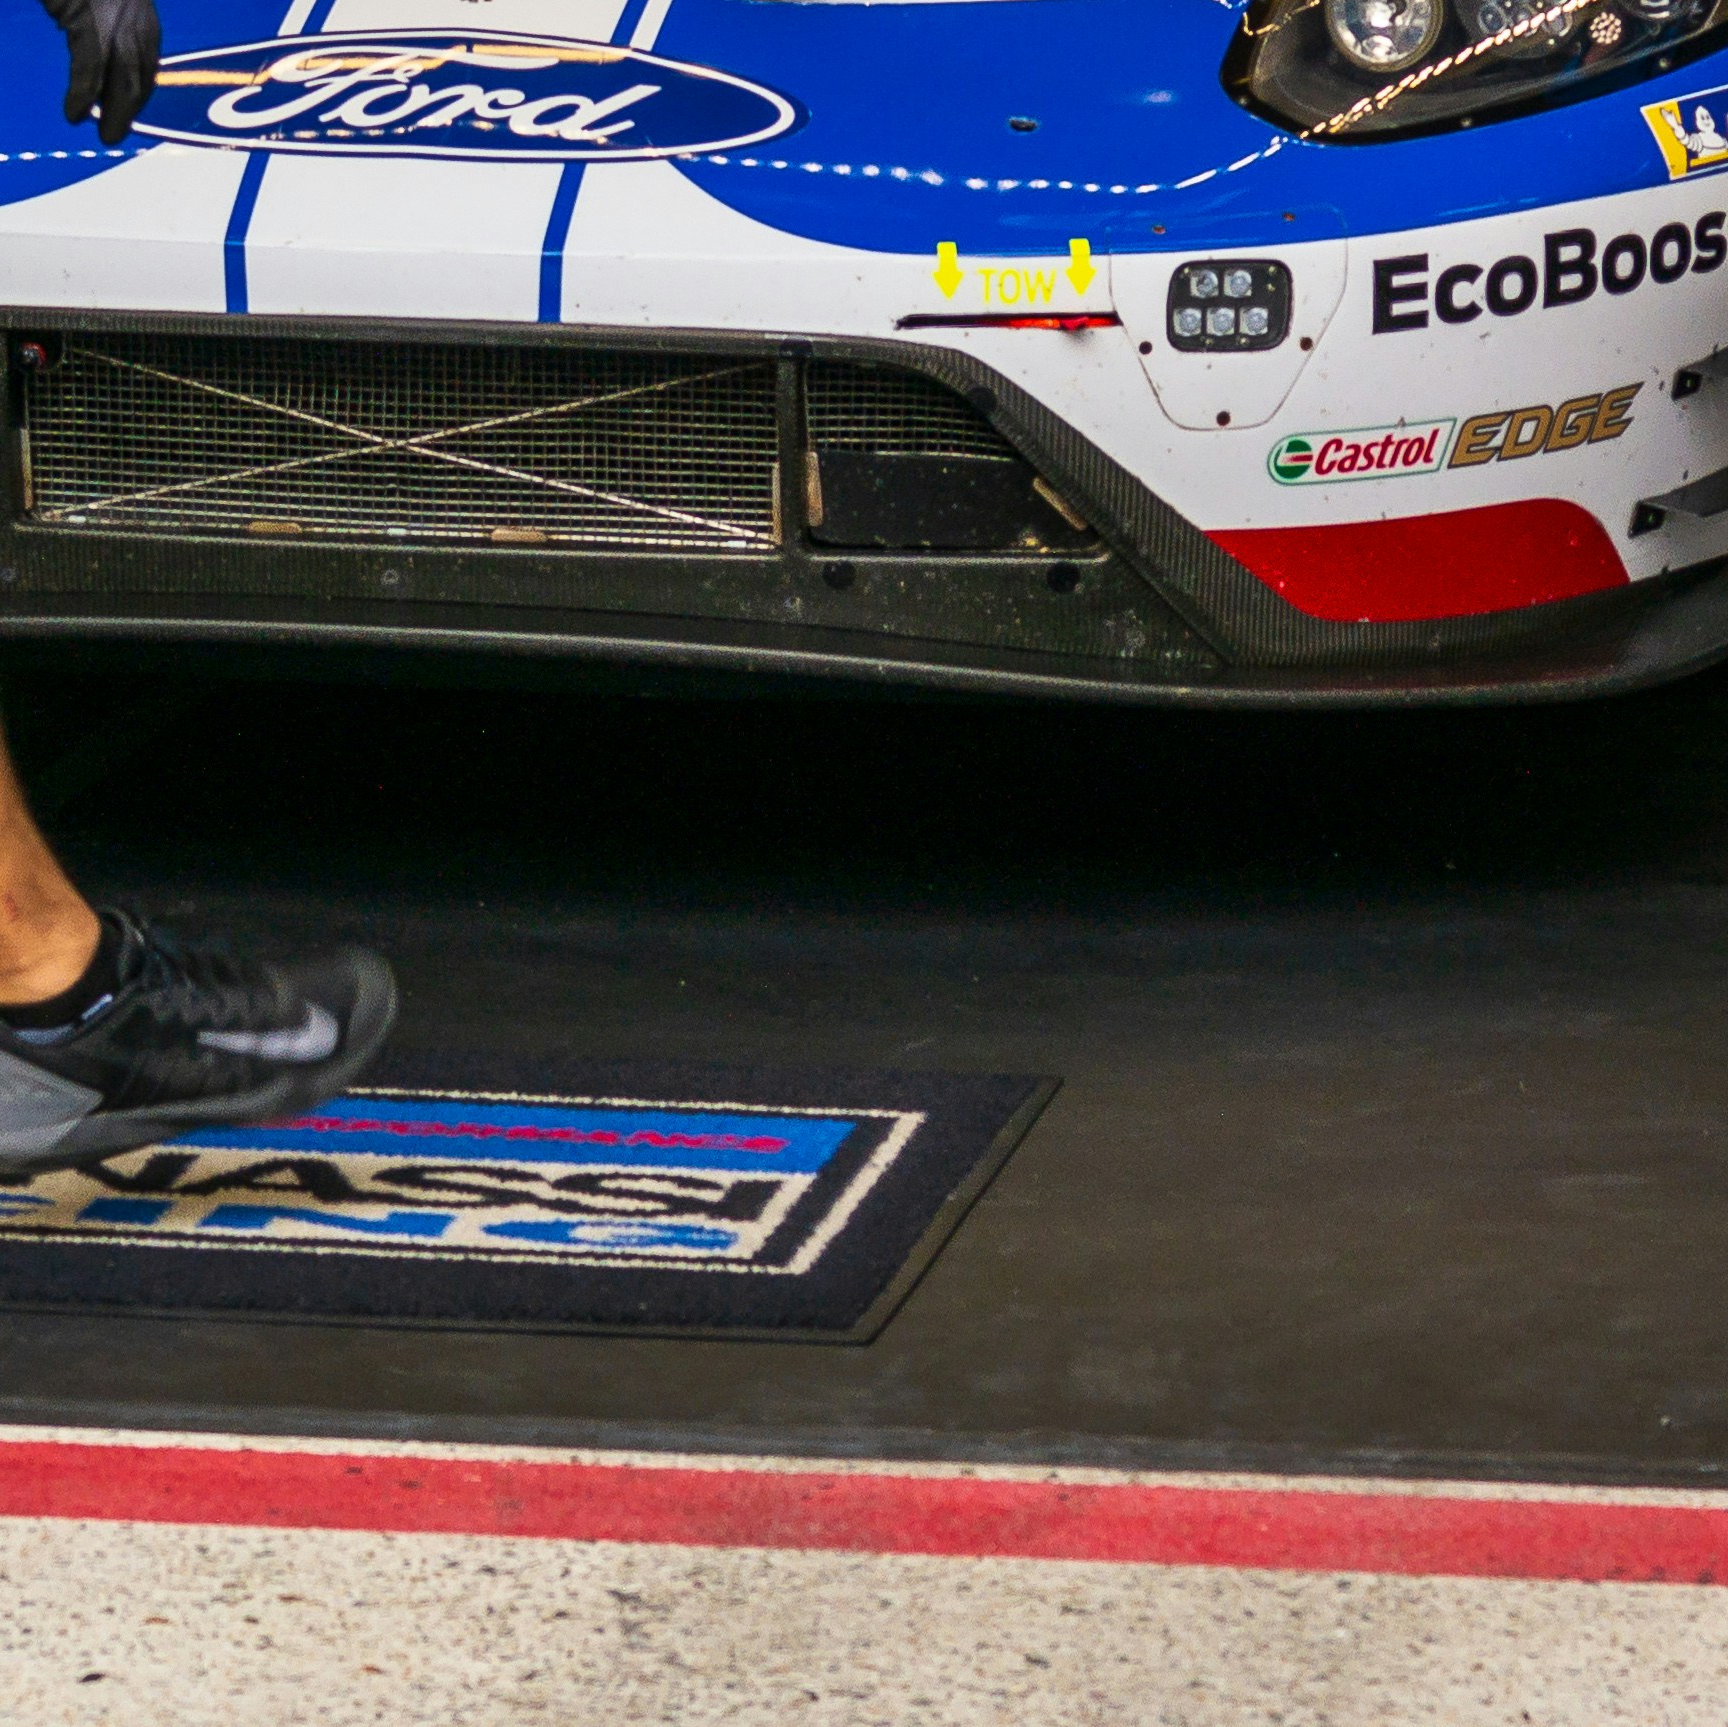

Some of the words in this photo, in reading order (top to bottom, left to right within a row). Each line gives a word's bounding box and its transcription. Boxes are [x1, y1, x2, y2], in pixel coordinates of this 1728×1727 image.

[209, 47, 662, 141] Ford
[976, 265, 1055, 306] TOW
[1314, 426, 1440, 479] Castrol
[1448, 383, 1644, 470] EDGE
